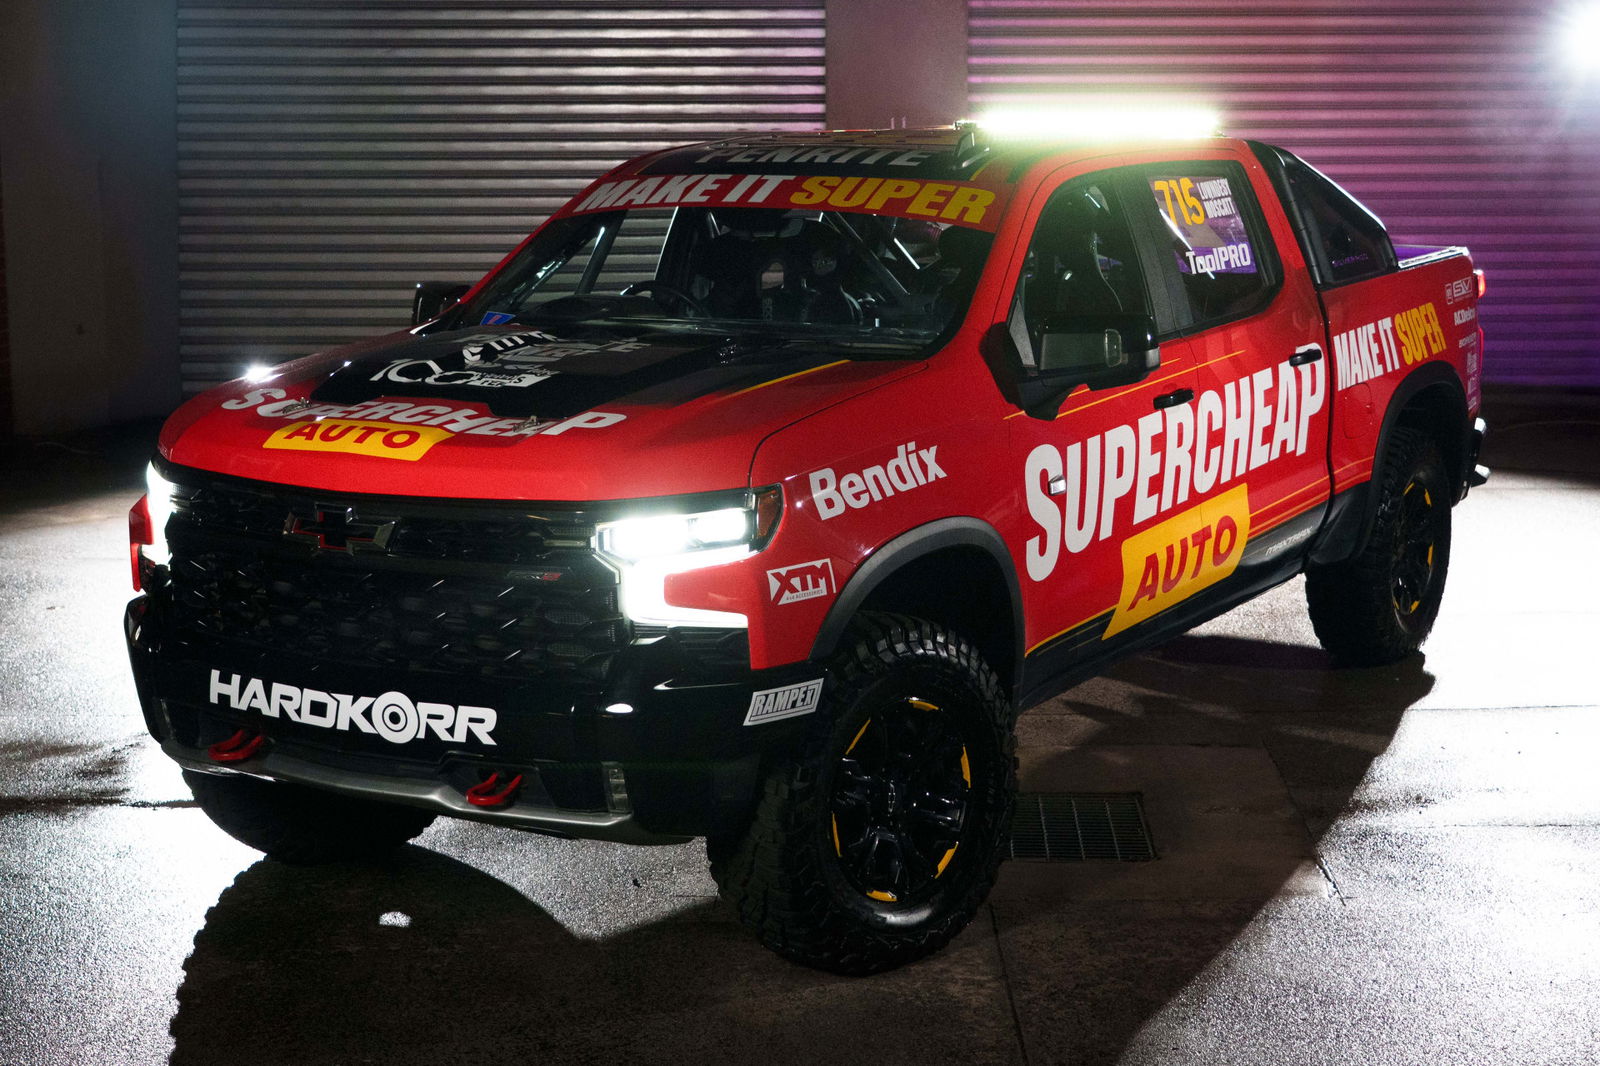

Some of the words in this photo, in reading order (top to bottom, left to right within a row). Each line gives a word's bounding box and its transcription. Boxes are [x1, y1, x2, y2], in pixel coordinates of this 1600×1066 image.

[575, 174, 721, 213] MAKE
[723, 174, 796, 204] IT
[788, 176, 997, 225] SUPER
[1154, 177, 1205, 228] 715
[1185, 243, 1251, 275] ToolPRO
[1333, 323, 1384, 391] MAKE
[1378, 317, 1400, 372] IT
[1394, 302, 1447, 366] SUPER
[284, 423, 421, 449] AUTO
[1024, 342, 1326, 582] SUPERCHEAP
[808, 441, 948, 521] Bendix
[770, 560, 830, 603] XTM
[1127, 515, 1238, 612] AUTO
[209, 668, 498, 745] HARDKORR
